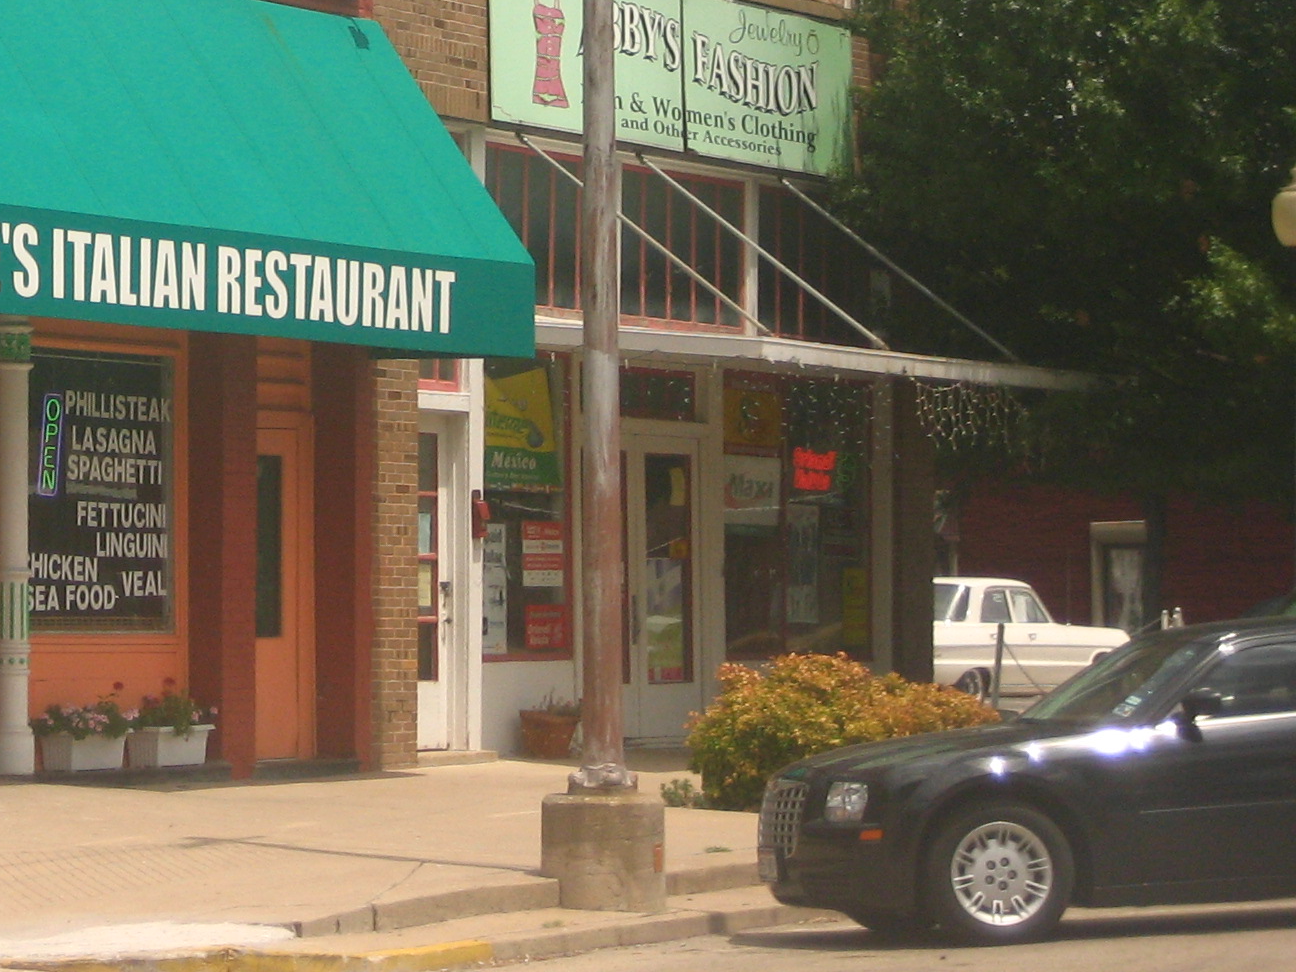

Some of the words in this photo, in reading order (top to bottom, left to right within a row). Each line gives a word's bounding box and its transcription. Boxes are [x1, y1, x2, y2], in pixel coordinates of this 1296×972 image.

[576, 0, 680, 72] BY'S
[729, 9, 803, 56] Jewelry
[692, 30, 819, 116] FASHION
[621, 117, 649, 131] and
[704, 130, 782, 156] Accessories
[630, 92, 647, 114] &
[652, 96, 735, 132] Women's
[742, 113, 817, 153] Clothing
[52, 228, 205, 311] ITALIAN
[217, 244, 456, 334] RESTAURANT
[65, 390, 171, 423] PHILLISTEAK
[42, 398, 61, 491] OPEN
[71, 425, 156, 455] LASAGNA
[67, 454, 162, 485] SPAGHETTI
[77, 501, 166, 529] FETTUCINI
[96, 532, 168, 559] LINGUINI
[28, 585, 60, 611] SEA
[66, 585, 116, 611] FOOD
[121, 570, 167, 597] VEAL
